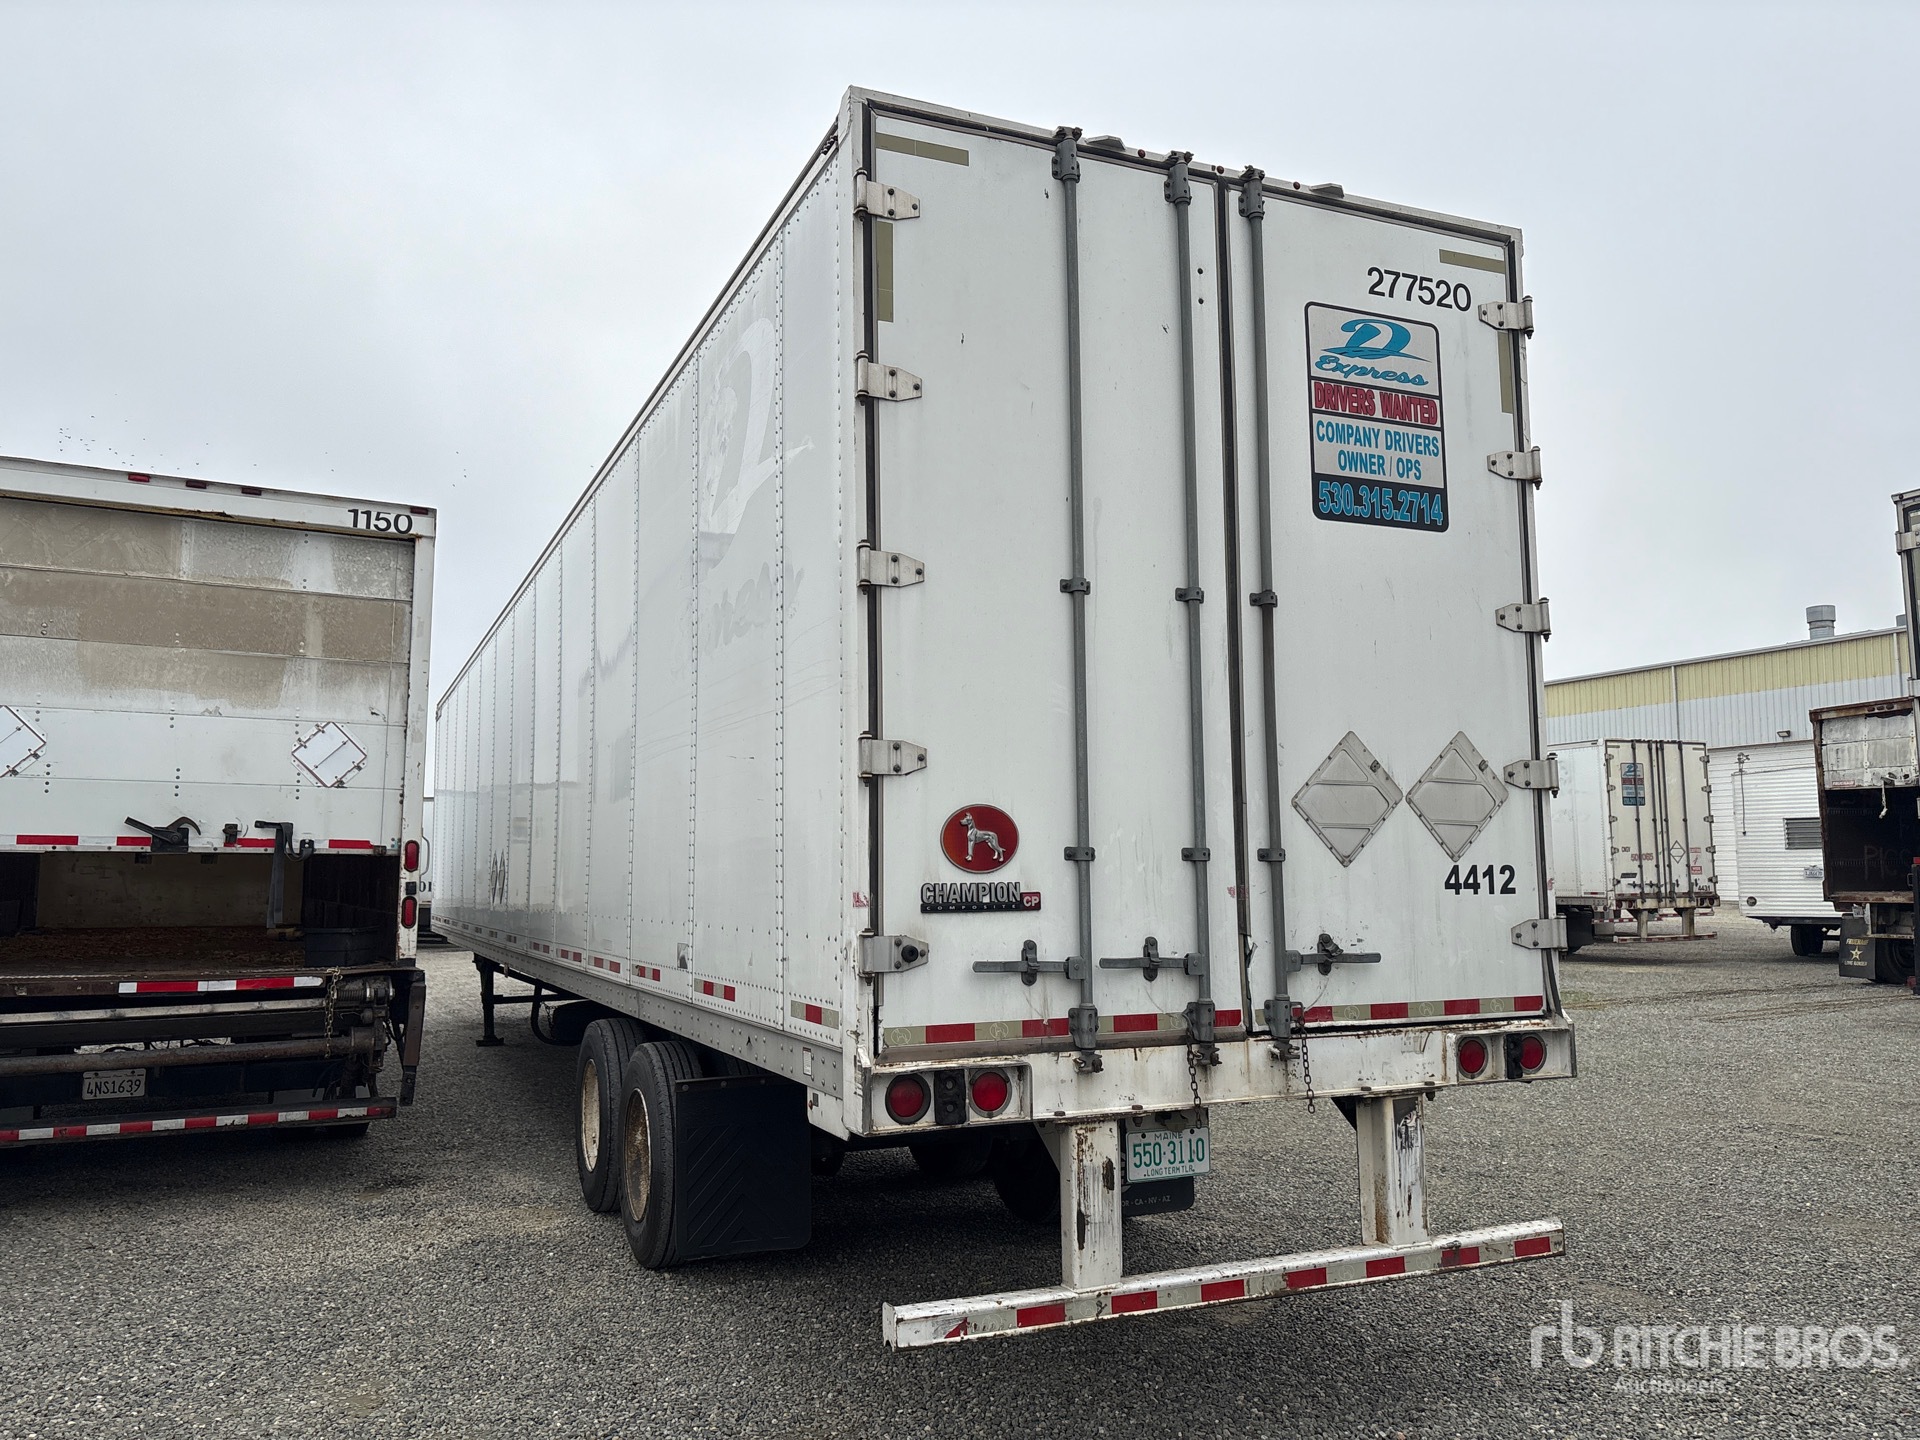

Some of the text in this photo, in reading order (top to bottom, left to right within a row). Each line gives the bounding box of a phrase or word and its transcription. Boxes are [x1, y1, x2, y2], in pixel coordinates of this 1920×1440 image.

[1367, 266, 1472, 312] 277520
[1314, 355, 1429, 386] Express
[1313, 382, 1438, 426] DRIVERS WANTED
[1316, 420, 1440, 457] COMPANY DRIVERS
[1337, 449, 1385, 476] OWNER
[1396, 456, 1422, 481] OPS
[1318, 480, 1444, 526] 530.315.2714
[347, 508, 413, 535] 1150
[921, 881, 1040, 907] CHAMPION CP
[1445, 865, 1516, 895] 4412
[86, 1079, 142, 1096] 4NS1639
[1154, 1132, 1184, 1141] MAINE
[1146, 1169, 1164, 1177] LONG
[1164, 1166, 1181, 1175] TERM
